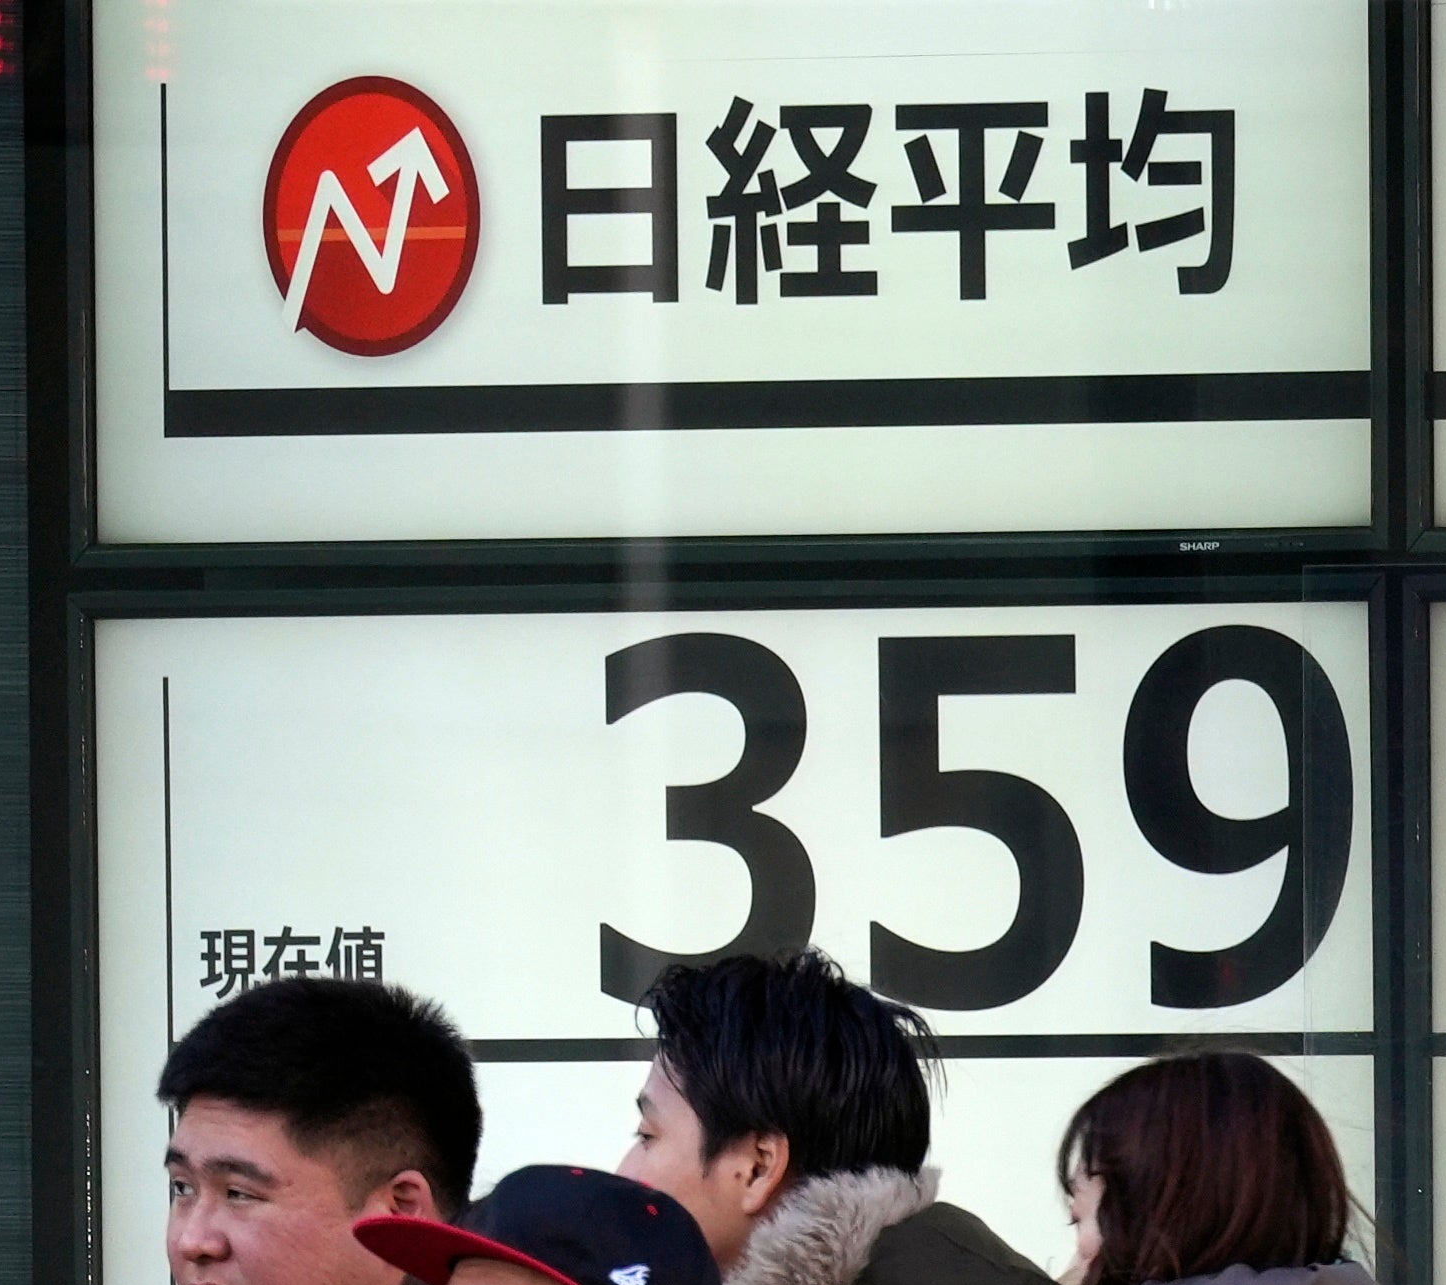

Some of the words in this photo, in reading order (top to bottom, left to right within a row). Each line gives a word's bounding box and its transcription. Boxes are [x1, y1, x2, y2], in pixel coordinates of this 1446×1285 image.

[541, 88, 1236, 306] 日経平均
[1180, 542, 1219, 551] SHARP
